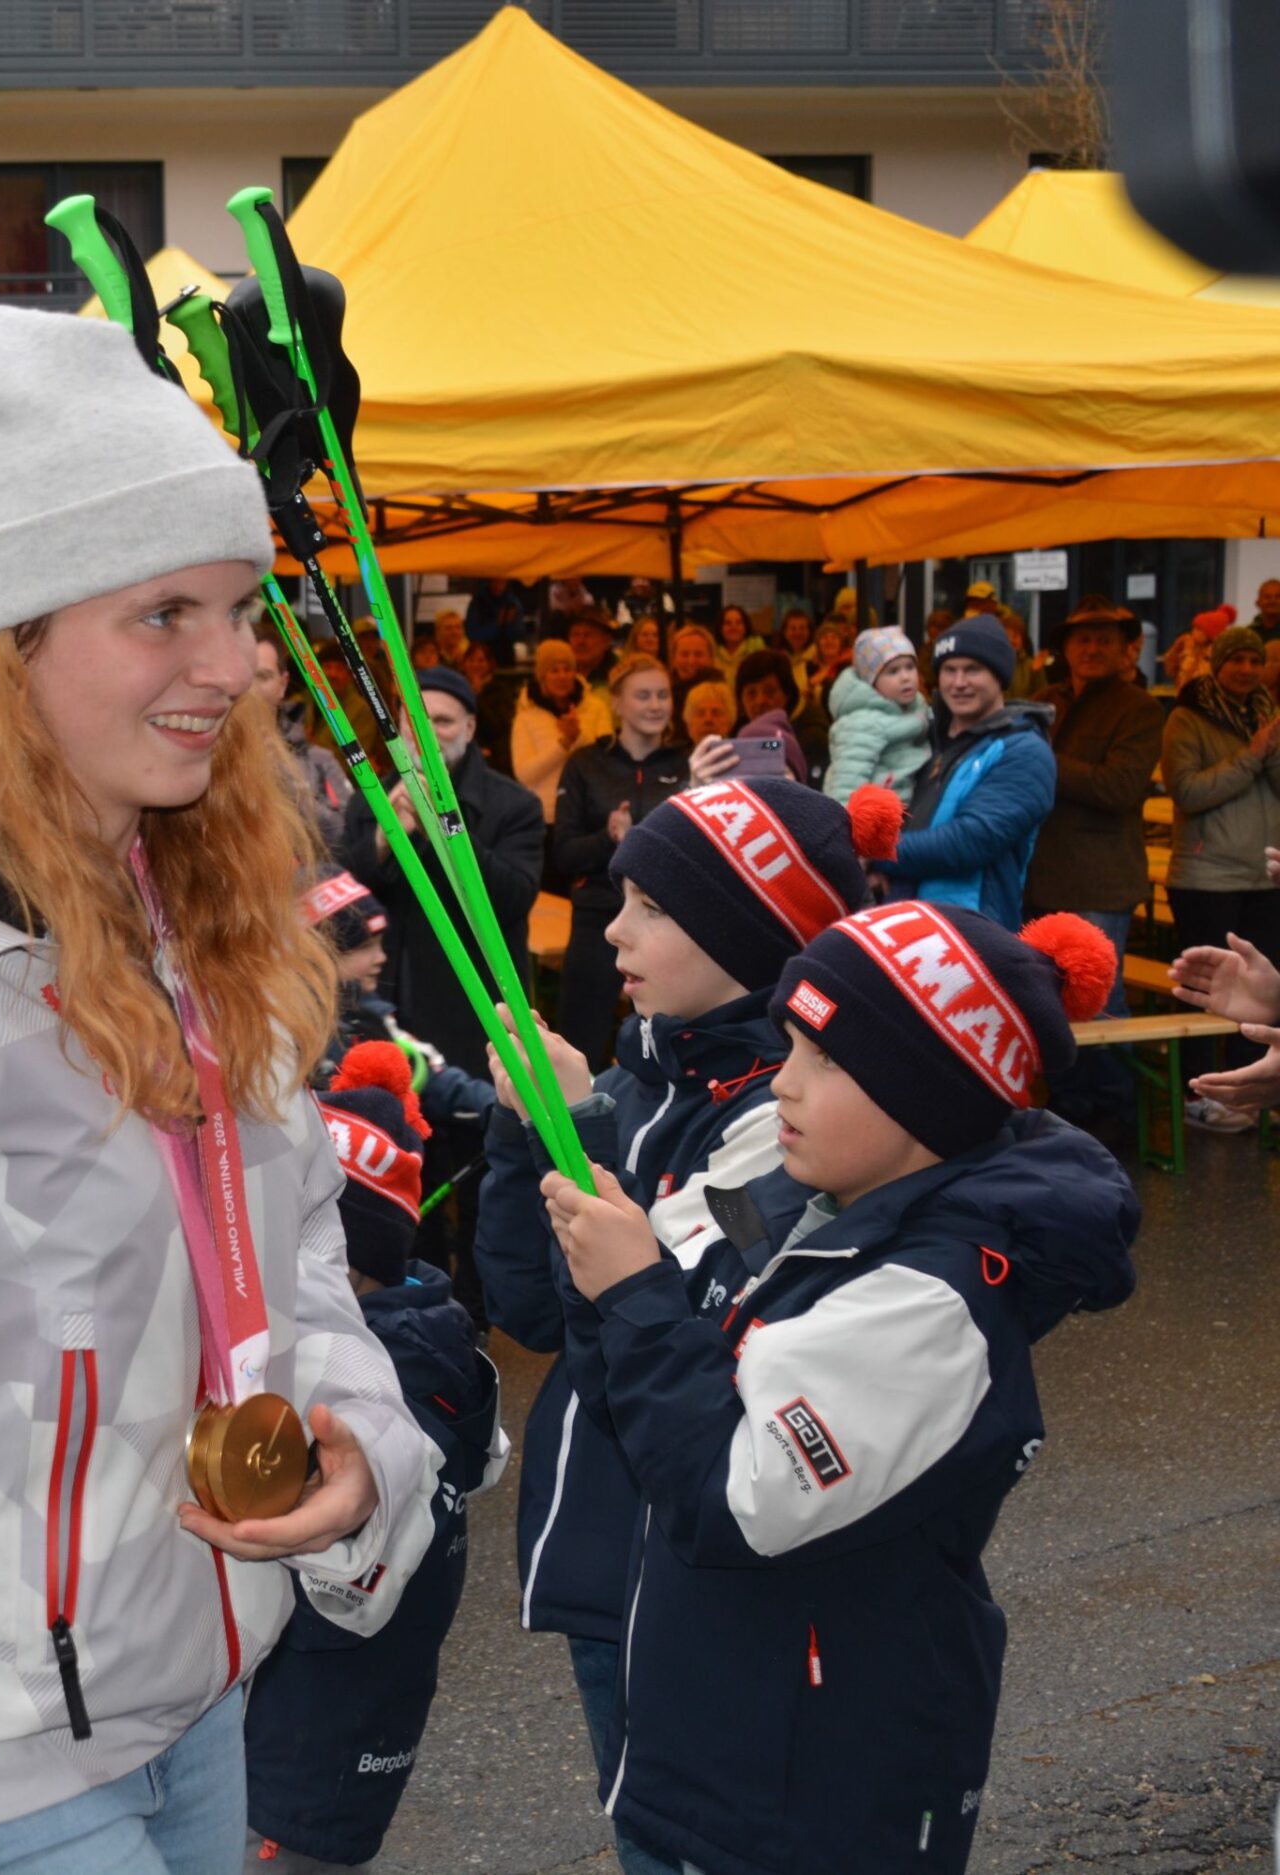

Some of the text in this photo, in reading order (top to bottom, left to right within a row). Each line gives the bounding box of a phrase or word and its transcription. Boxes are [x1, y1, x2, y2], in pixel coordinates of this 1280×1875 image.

[356, 665, 388, 720] KOMPERDELL
[793, 998, 822, 1025] WEAR
[796, 986, 830, 1017] HUSKI
[213, 1112, 248, 1299] MILANO CORTINA 2026
[766, 1420, 789, 1449] Sport
[786, 1450, 798, 1466] am
[309, 1576, 328, 1589] ort
[330, 1584, 345, 1597] am
